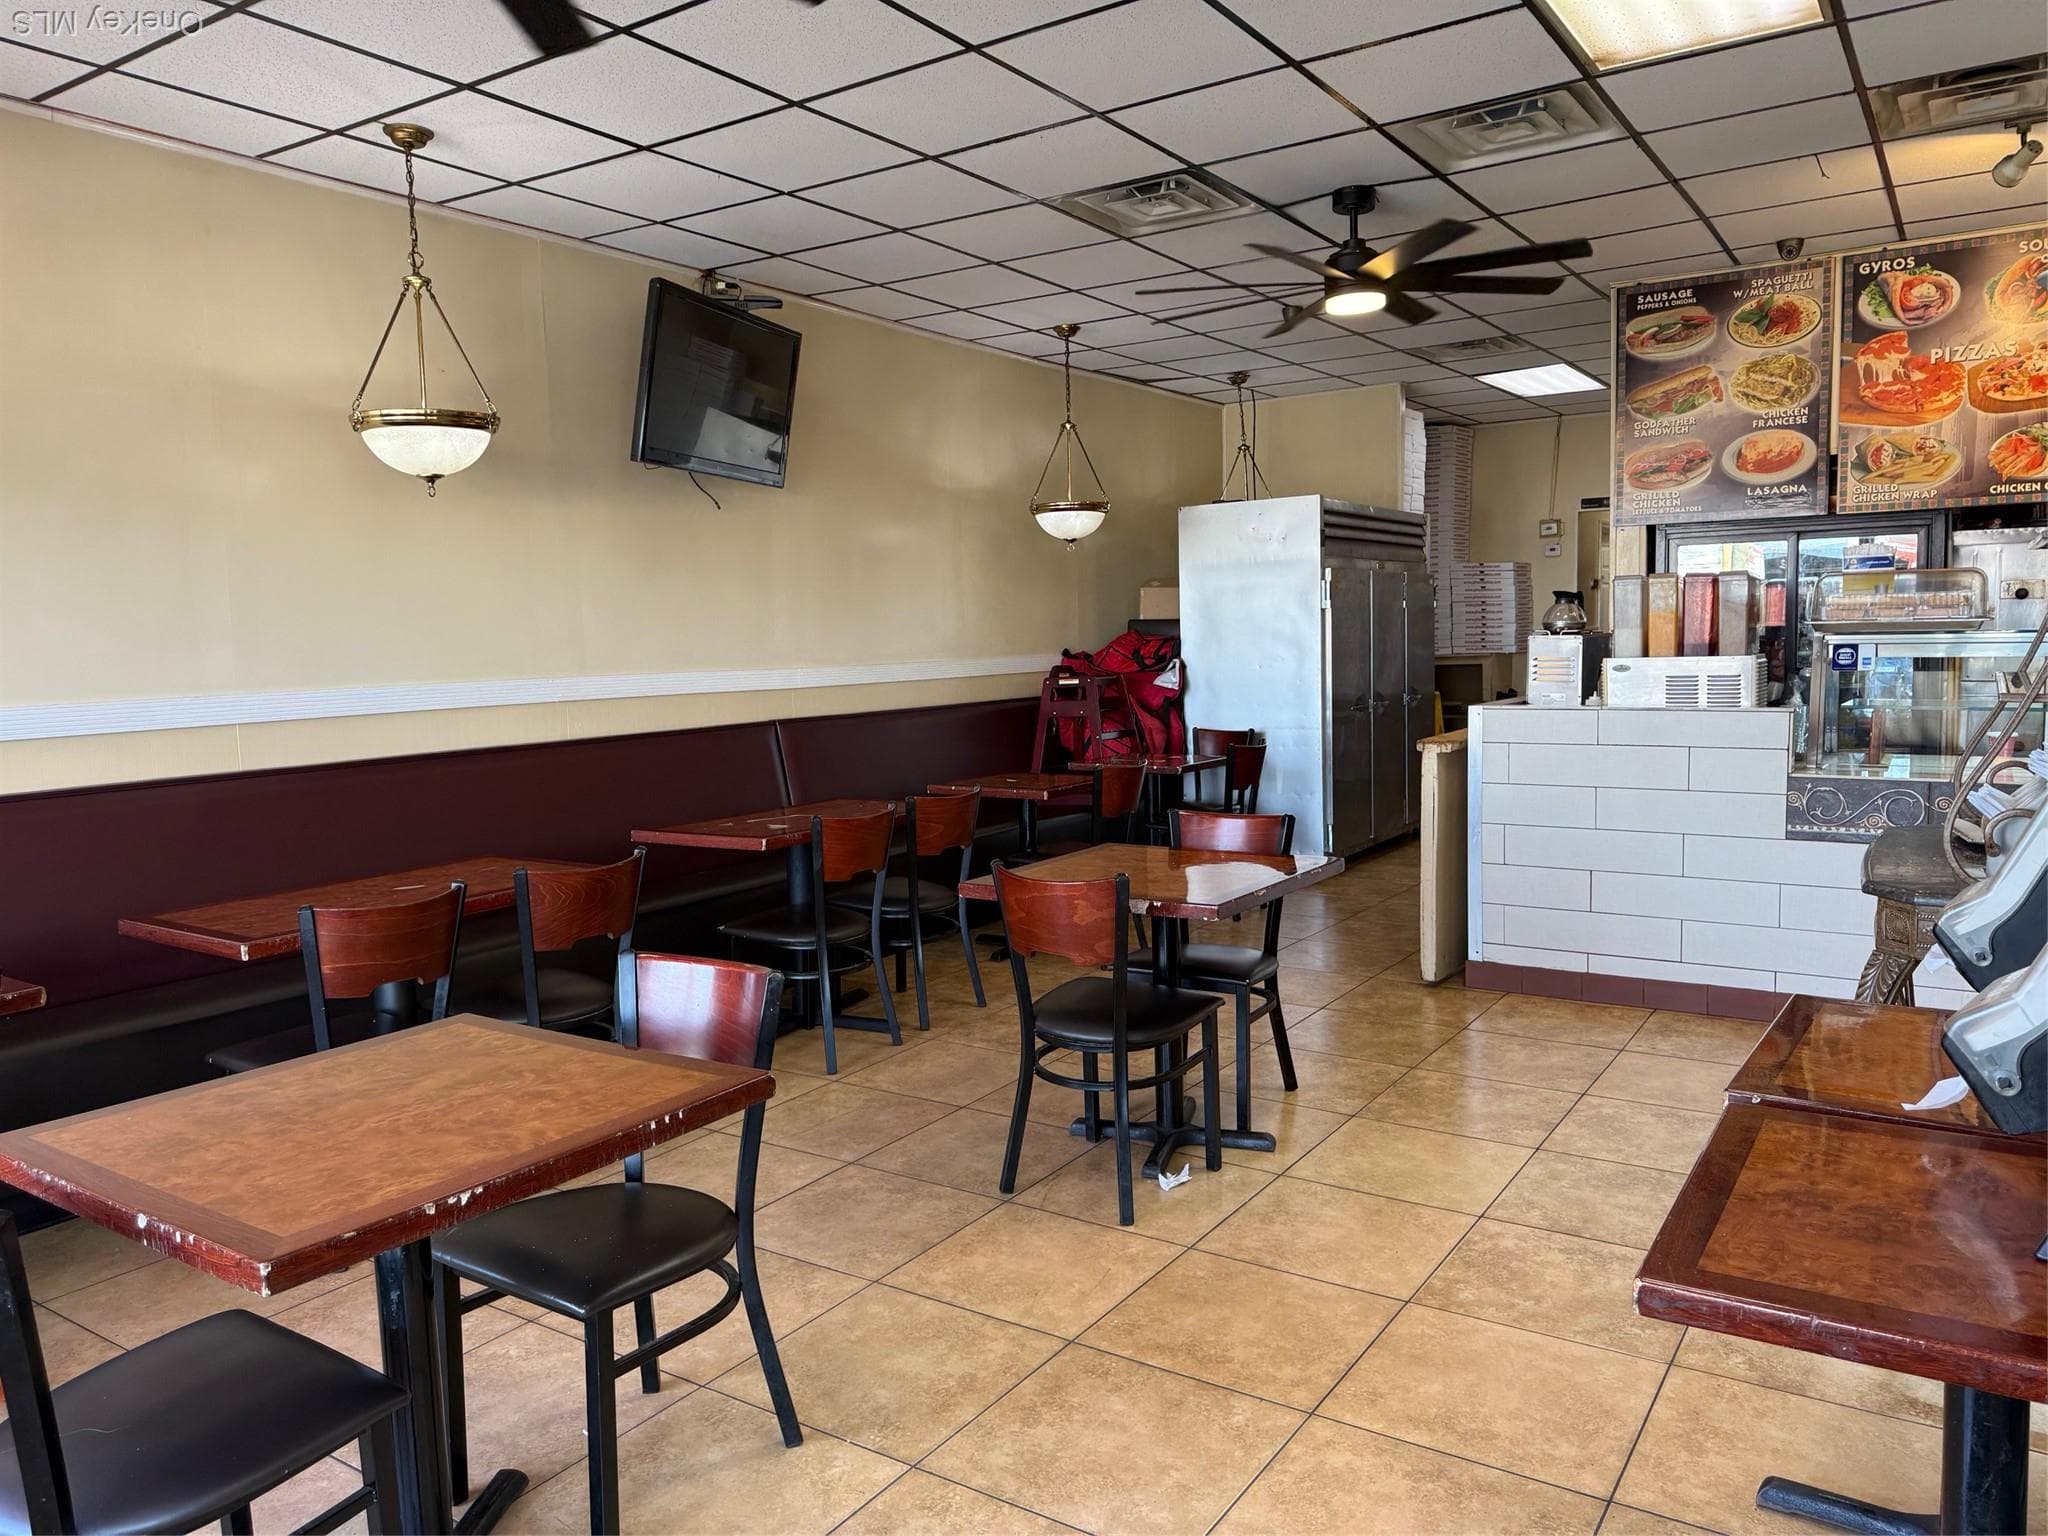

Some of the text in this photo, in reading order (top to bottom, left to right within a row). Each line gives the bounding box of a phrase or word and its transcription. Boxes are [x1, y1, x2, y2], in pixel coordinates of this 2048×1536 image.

[1859, 256, 1915, 275] GYROS
[1751, 272, 1813, 288] SPAGUETTI
[1637, 288, 1694, 304] SAUSAGE
[1733, 280, 1813, 299] W/MEAT BALL
[1636, 301, 1663, 311] PEPPERS
[1671, 297, 1697, 306] ONIONS
[1930, 340, 2018, 365] PIZZAS
[1762, 407, 1809, 419] CHICKEN
[1634, 416, 1696, 430] GODFATHER
[1752, 415, 1809, 428] FRANCESE
[1633, 425, 1689, 438] SANDWICH
[1747, 483, 1808, 496] LASAGNA
[1853, 483, 1898, 495] GRILLED
[1989, 481, 2041, 495] CHICKEN
[1632, 490, 1680, 501] GRILLED
[1852, 489, 1938, 503] CHICKEN WRAP
[1632, 498, 1681, 509] CHICKEN
[1632, 507, 1658, 515] LETTUCE
[1666, 505, 1702, 514] TOMATOES
